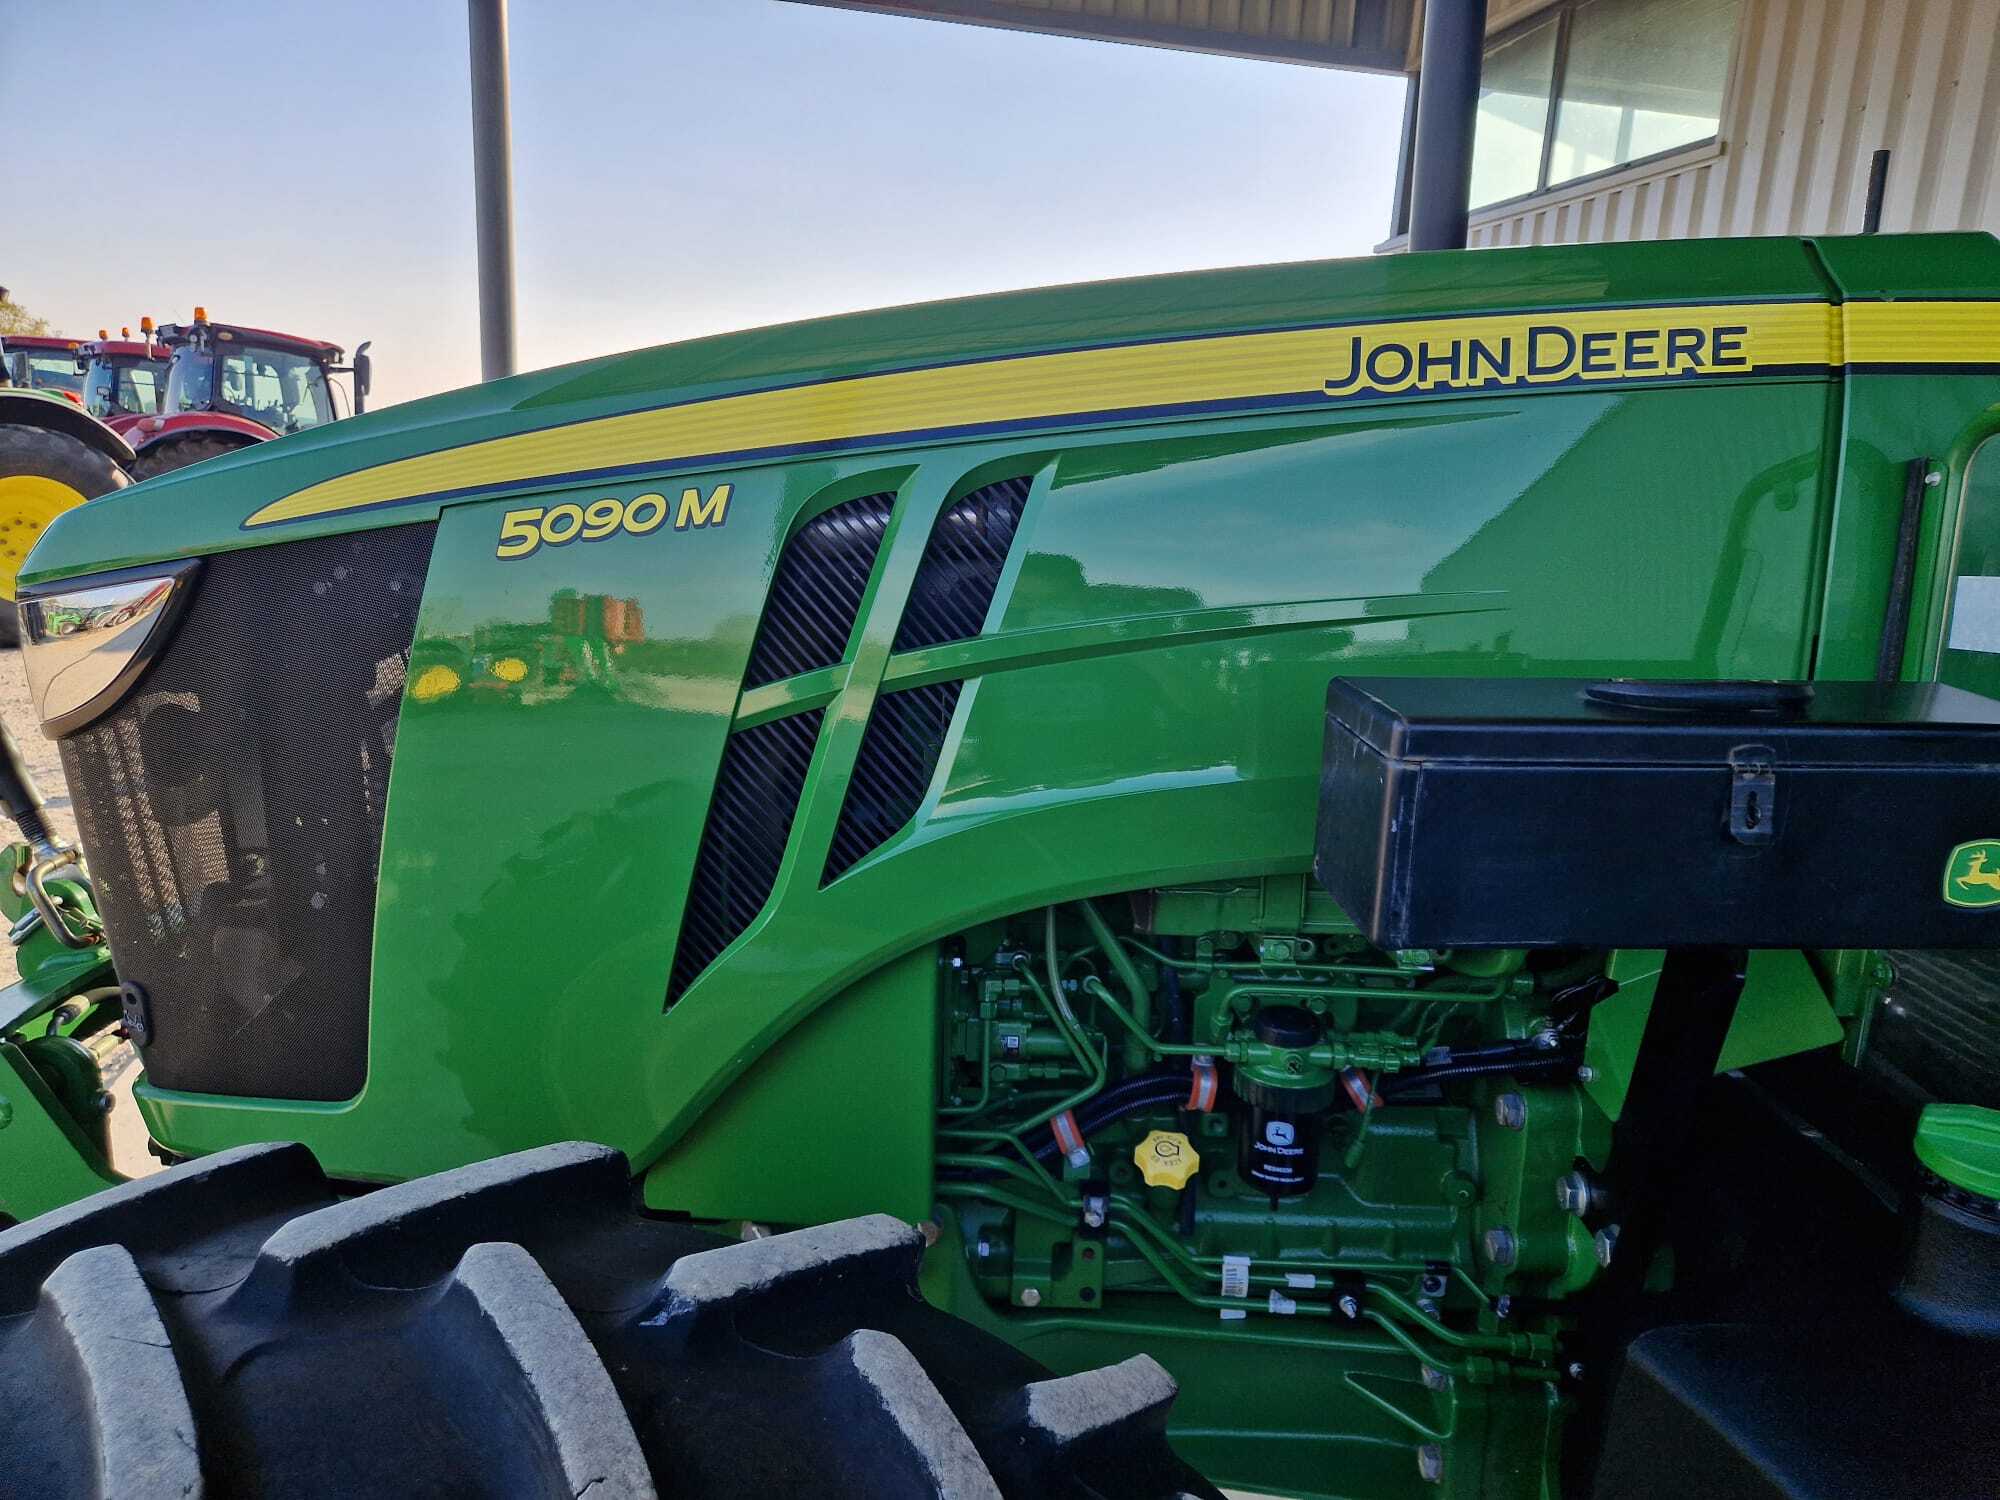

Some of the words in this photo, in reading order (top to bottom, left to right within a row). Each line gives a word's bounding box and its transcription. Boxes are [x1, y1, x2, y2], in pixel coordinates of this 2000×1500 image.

[1325, 337, 1512, 390] JOHN
[1527, 326, 1748, 373] DEERE
[496, 493, 669, 560] 5090
[674, 484, 734, 532] M
